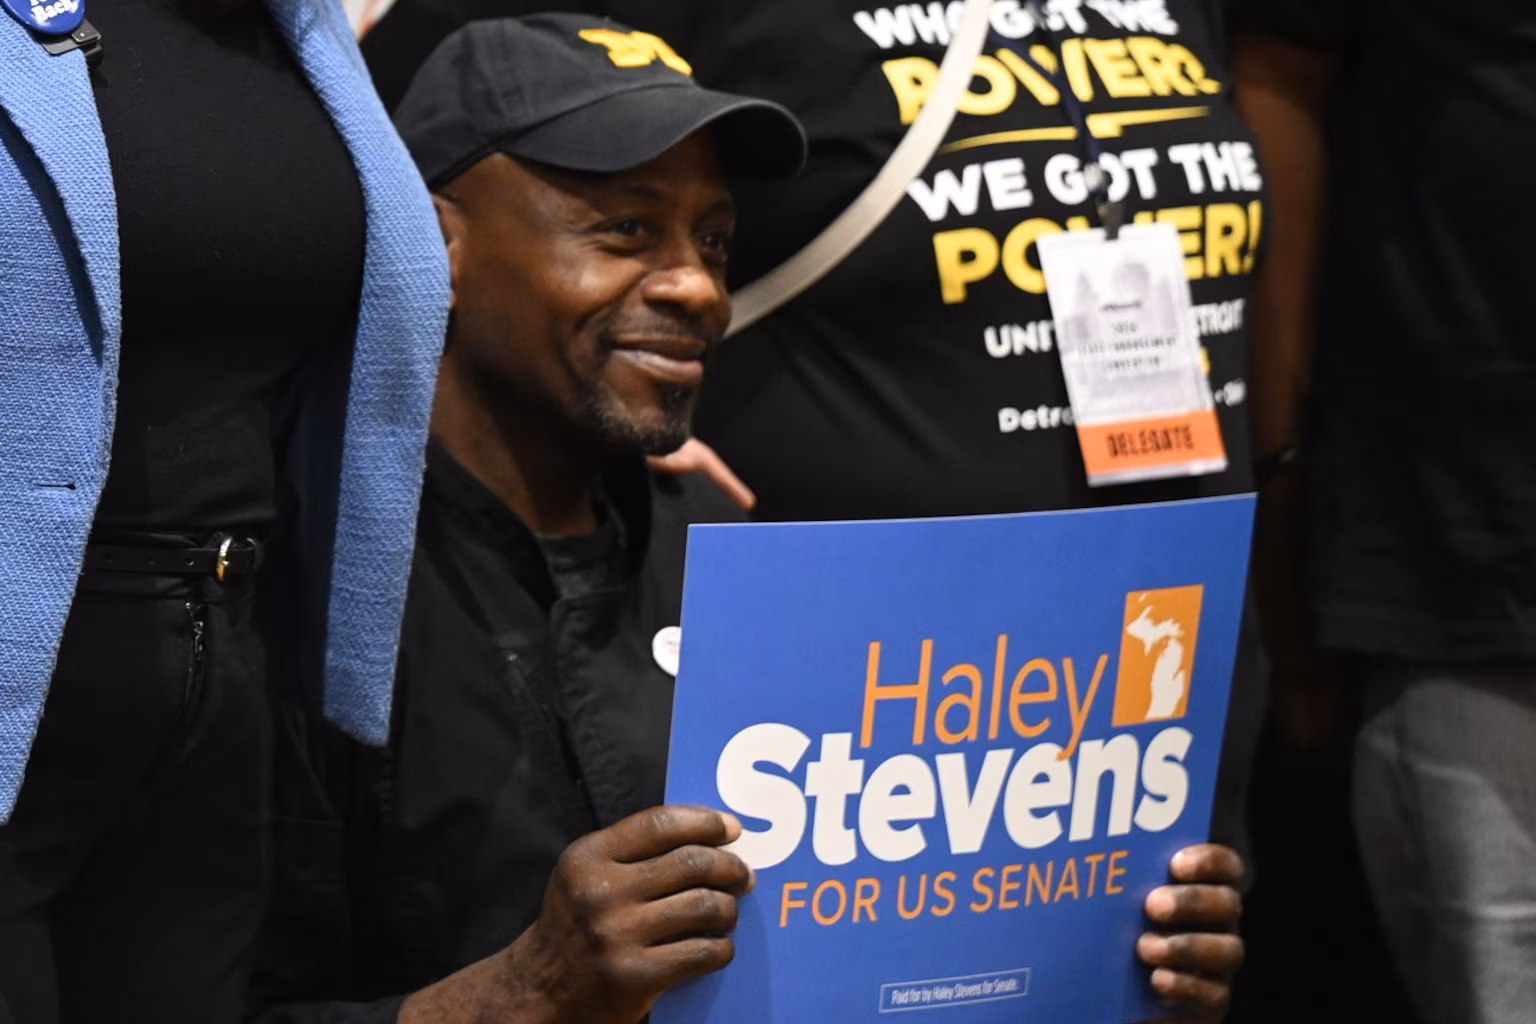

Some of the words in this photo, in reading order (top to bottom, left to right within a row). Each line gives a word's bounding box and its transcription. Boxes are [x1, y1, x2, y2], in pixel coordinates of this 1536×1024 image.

[906, 157, 1034, 222] WE
[1044, 148, 1159, 204] GOT
[1168, 141, 1263, 194] THE
[932, 199, 1263, 304] POER!
[998, 405, 1074, 433] Detr
[1107, 425, 1194, 458] DELEGATE
[860, 634, 1108, 763] Haley
[715, 722, 1194, 869] Stevens
[778, 878, 882, 927] FOR
[897, 870, 956, 920] US
[969, 850, 1129, 913] SENATE
[891, 989, 908, 1005] Paid
[932, 985, 953, 1001] Haley
[954, 982, 982, 998] Stevens
